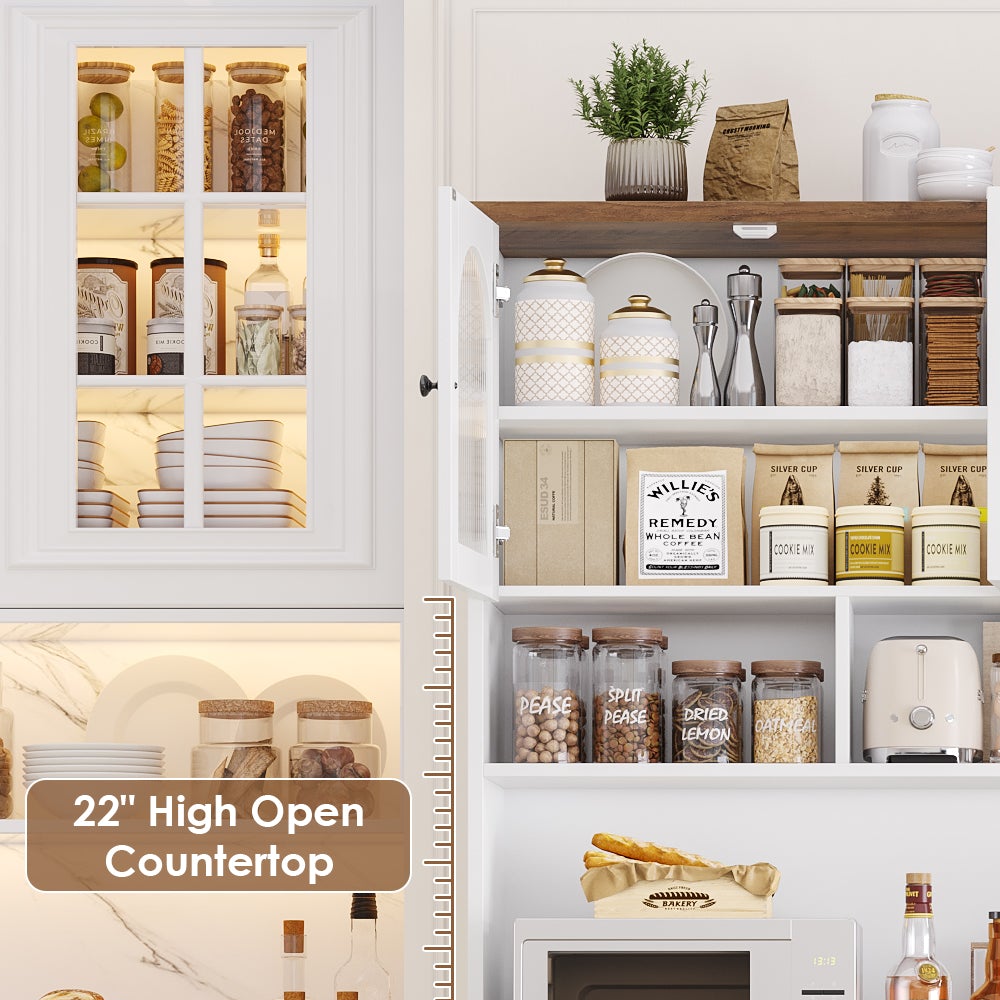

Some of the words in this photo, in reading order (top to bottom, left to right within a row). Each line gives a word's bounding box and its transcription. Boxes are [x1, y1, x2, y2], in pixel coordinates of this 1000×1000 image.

[770, 465, 799, 473] SILVER
[801, 465, 818, 473] CUP
[856, 465, 884, 473] SILVER
[886, 465, 903, 473] CUP
[940, 465, 968, 473] SILVER
[970, 465, 987, 473] CUP
[540, 476, 549, 490] 34
[647, 479, 720, 502] WILLIE'S
[540, 491, 549, 521] ESUD
[649, 518, 718, 528] REMEDY
[645, 532, 685, 540] WHOLE
[689, 532, 721, 540] BEAN
[774, 543, 801, 556] COOKIE
[802, 544, 815, 556] MIX
[850, 543, 877, 555] COOKIE
[878, 543, 891, 555] MIX
[926, 543, 953, 556] COOKIE
[954, 543, 967, 555] MIX
[607, 687, 644, 703] SPLIT
[520, 695, 572, 715] PEASE
[604, 709, 648, 725] PEASE
[684, 707, 729, 721] DRIED
[755, 718, 817, 733] OATMEAL
[681, 727, 731, 741] LEMON
